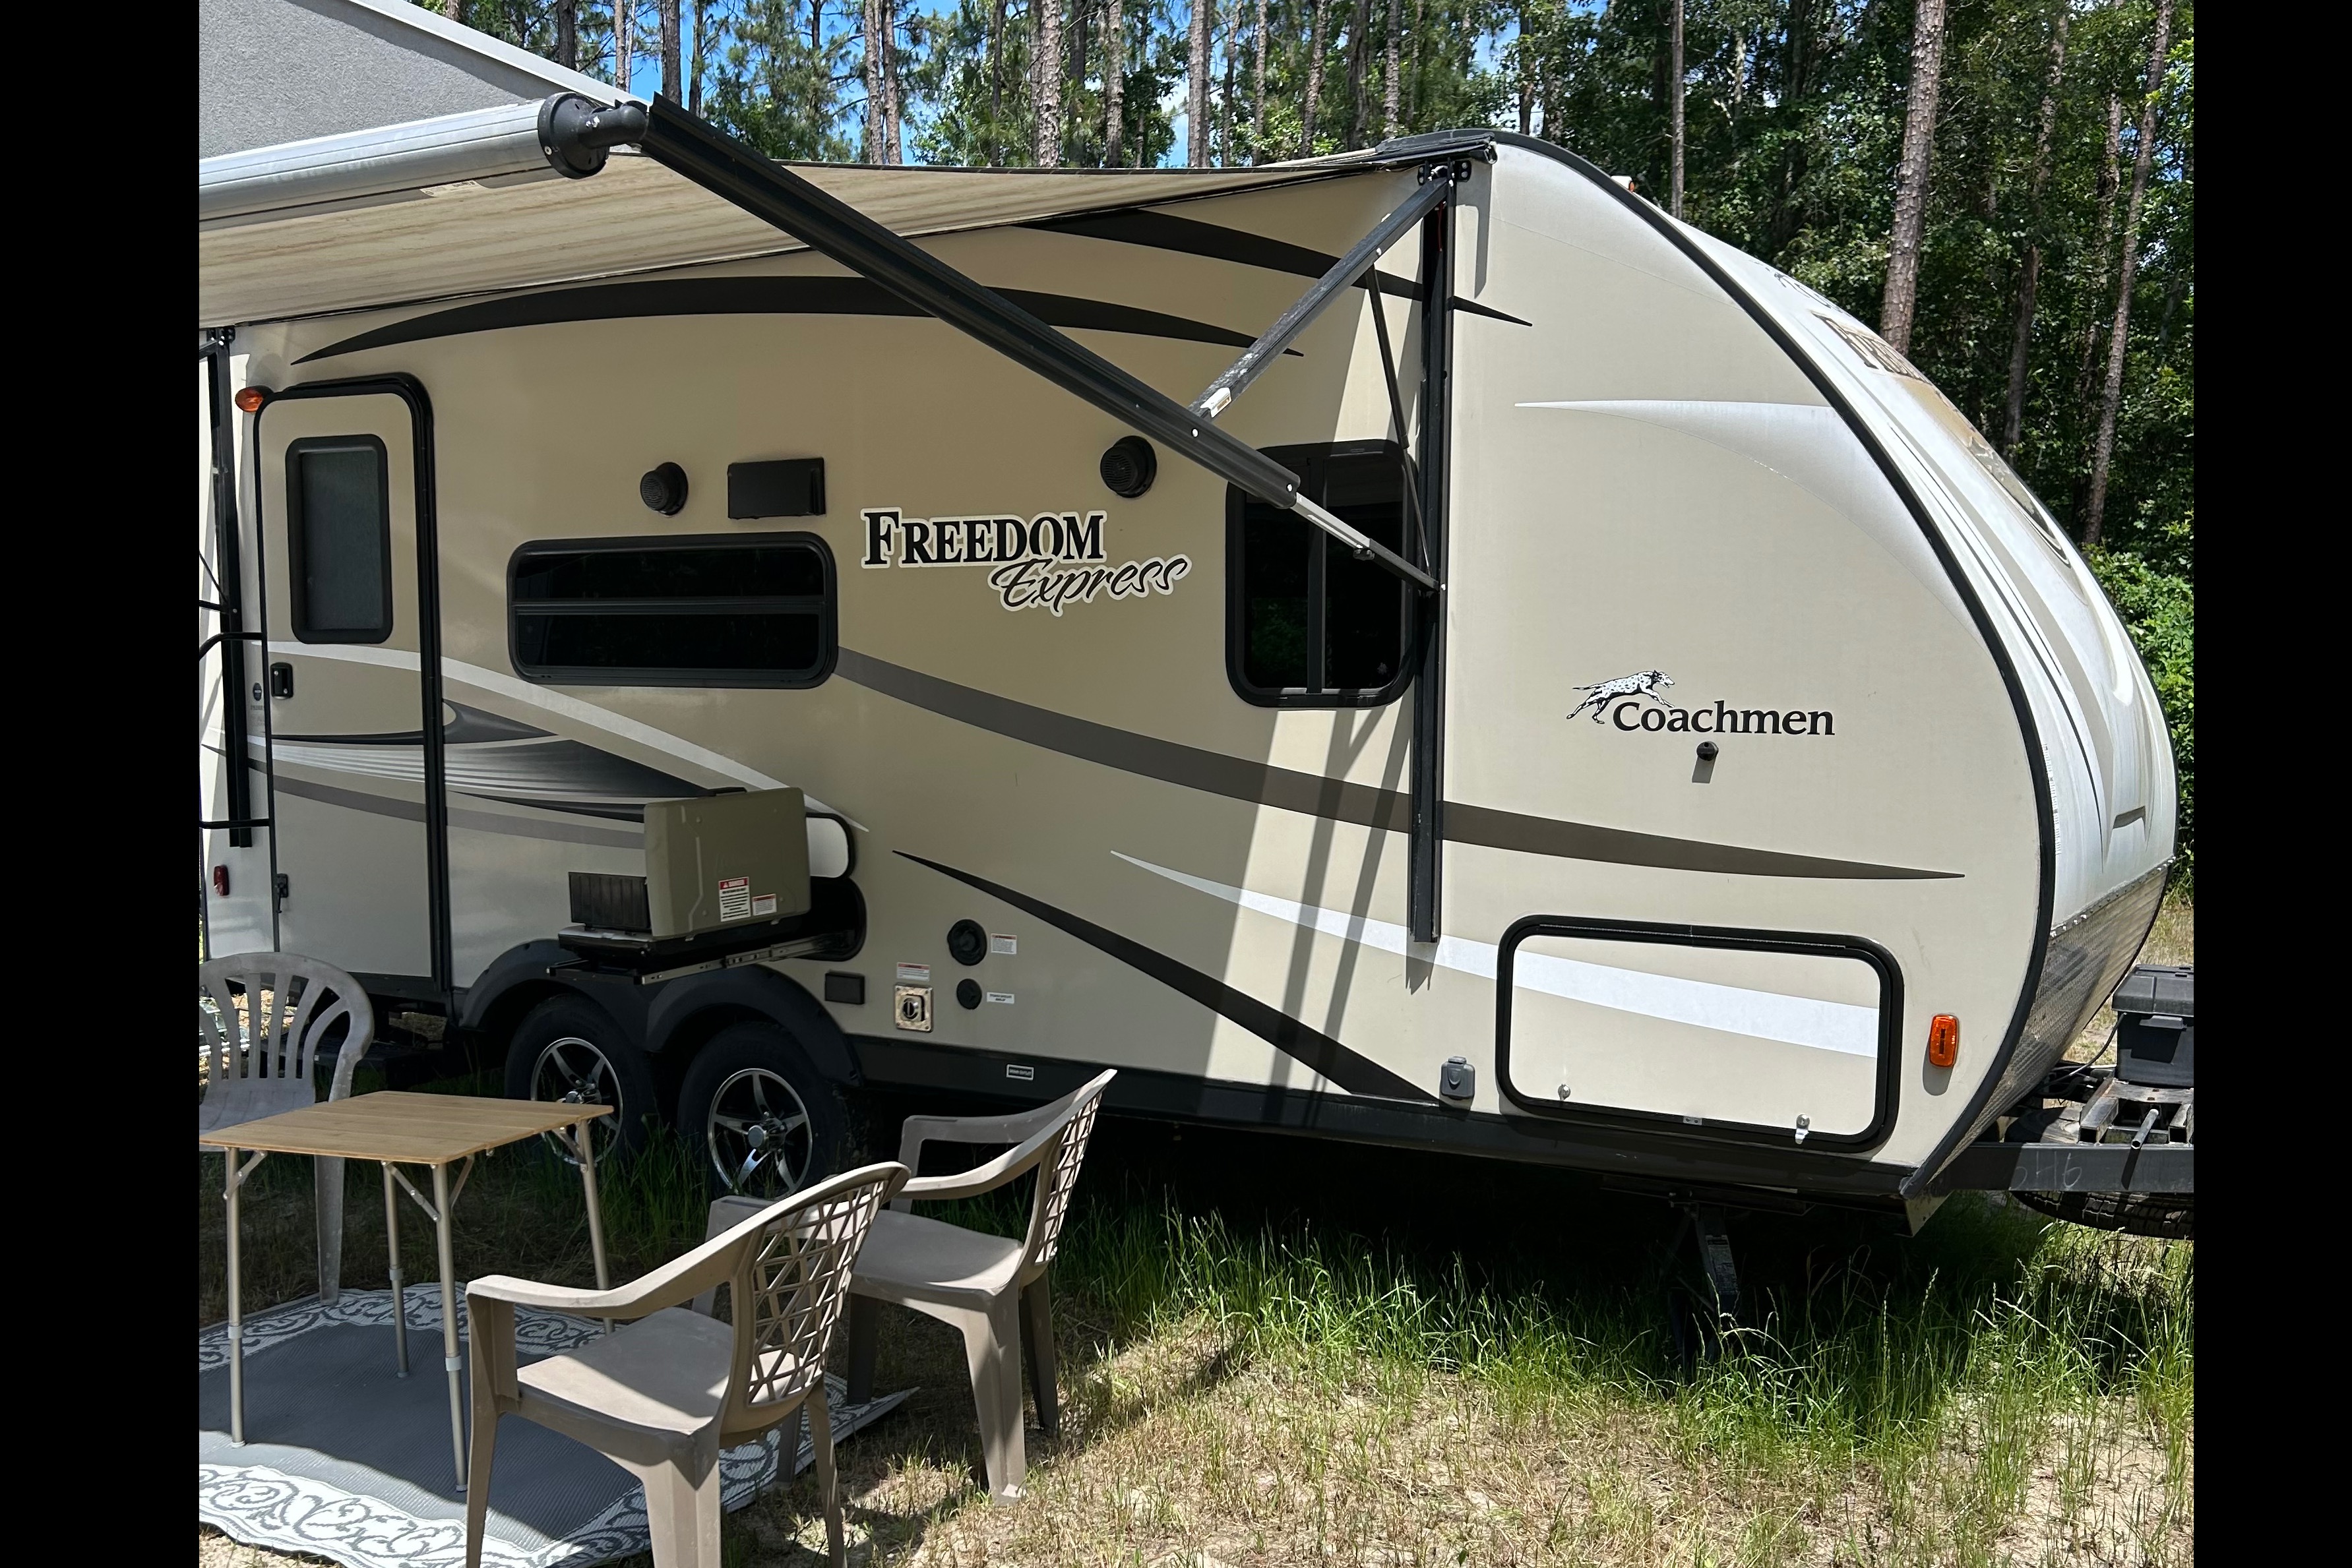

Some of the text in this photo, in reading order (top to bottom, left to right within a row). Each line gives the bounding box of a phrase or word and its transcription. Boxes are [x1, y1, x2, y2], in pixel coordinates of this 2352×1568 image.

[863, 511, 1104, 566] FREEDOM
[991, 557, 1188, 613] Express
[1613, 700, 1836, 736] Coachmen
